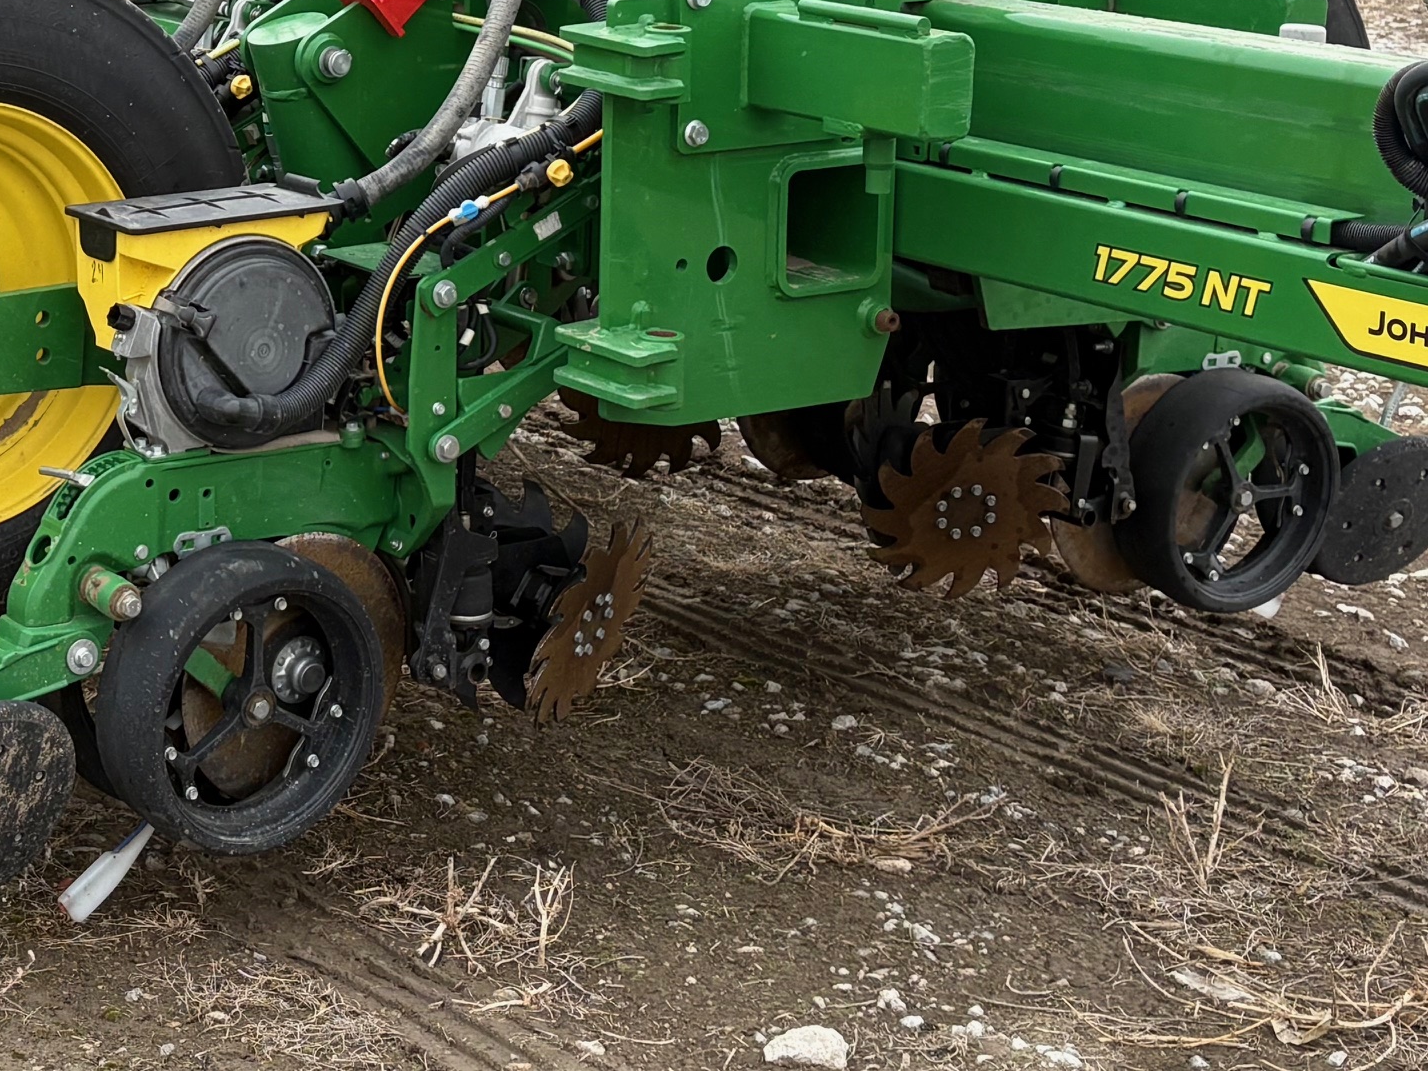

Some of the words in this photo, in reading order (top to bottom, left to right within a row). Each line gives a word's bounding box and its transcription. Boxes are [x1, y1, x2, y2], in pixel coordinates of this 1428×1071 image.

[1093, 244, 1198, 300] 1775
[1200, 268, 1272, 318] NT
[1368, 310, 1428, 348] JOH
